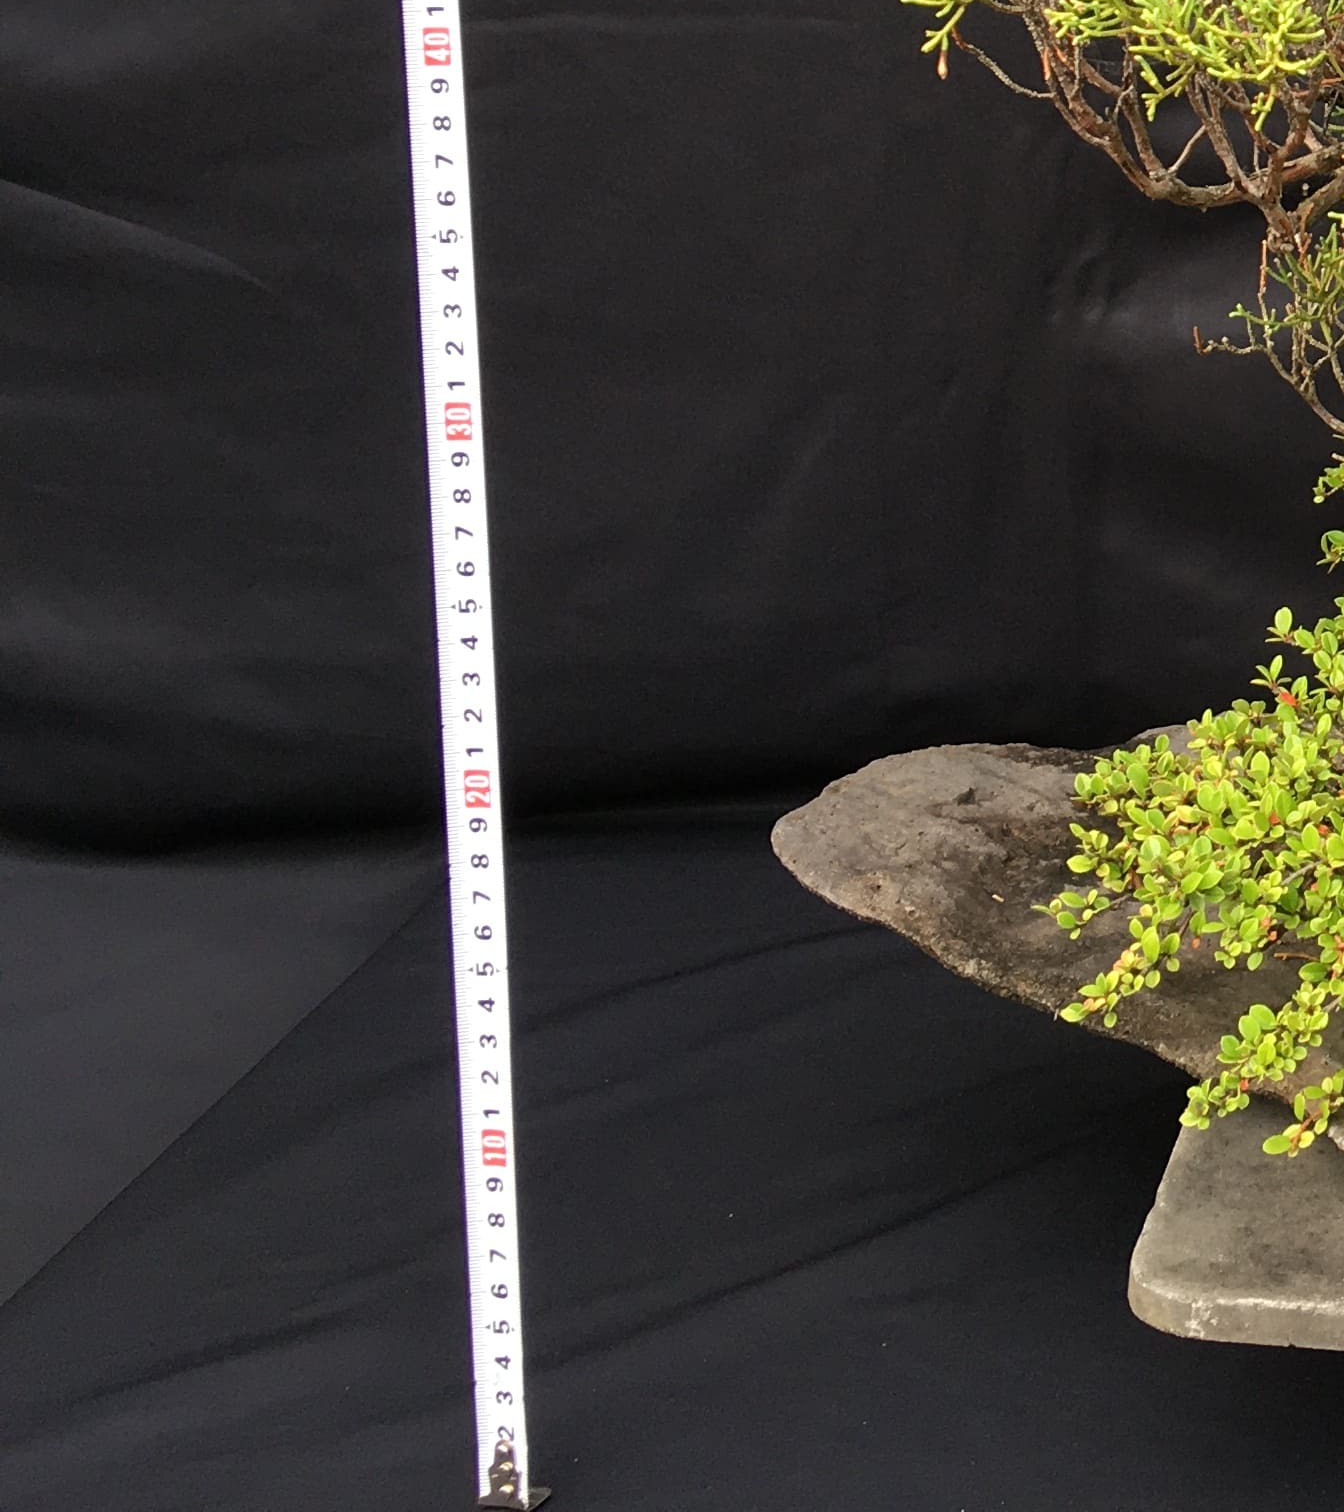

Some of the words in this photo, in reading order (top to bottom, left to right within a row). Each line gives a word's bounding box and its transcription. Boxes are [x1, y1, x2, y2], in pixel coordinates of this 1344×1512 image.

[426, 6, 445, 17] 1
[424, 30, 449, 64] 40
[430, 78, 450, 94] 9
[432, 115, 452, 132] 8
[434, 154, 454, 169] 7
[436, 190, 456, 207] 6
[438, 228, 458, 244] 5
[440, 265, 460, 282] 4
[442, 303, 463, 319] 3
[444, 340, 465, 357] 2
[446, 381, 466, 391] 1
[446, 405, 471, 438] 30
[450, 451, 470, 468] 9
[452, 488, 472, 504] 8
[454, 526, 474, 541] 7
[455, 560, 476, 577] 6
[458, 598, 478, 614] 5
[459, 634, 479, 651] 4
[461, 672, 481, 687] 3
[463, 708, 483, 724] 2
[465, 747, 484, 758] 1
[465, 773, 489, 806] 20
[468, 817, 488, 834] 9
[470, 853, 490, 869] 8
[472, 890, 491, 905] 7
[473, 924, 493, 941] 6
[475, 961, 495, 977] 5
[477, 997, 496, 1013] 4
[479, 1034, 498, 1049] 3
[480, 1069, 499, 1085] 2
[482, 1108, 501, 1119] 1
[483, 1132, 505, 1164] 10
[485, 1176, 504, 1193] 9
[487, 1212, 506, 1228] 8
[489, 1248, 507, 1263] 7
[490, 1283, 509, 1300] 6
[492, 1319, 510, 1335] 5
[494, 1355, 512, 1371] 4
[495, 1390, 514, 1406] 3
[497, 1425, 515, 1442] 2
